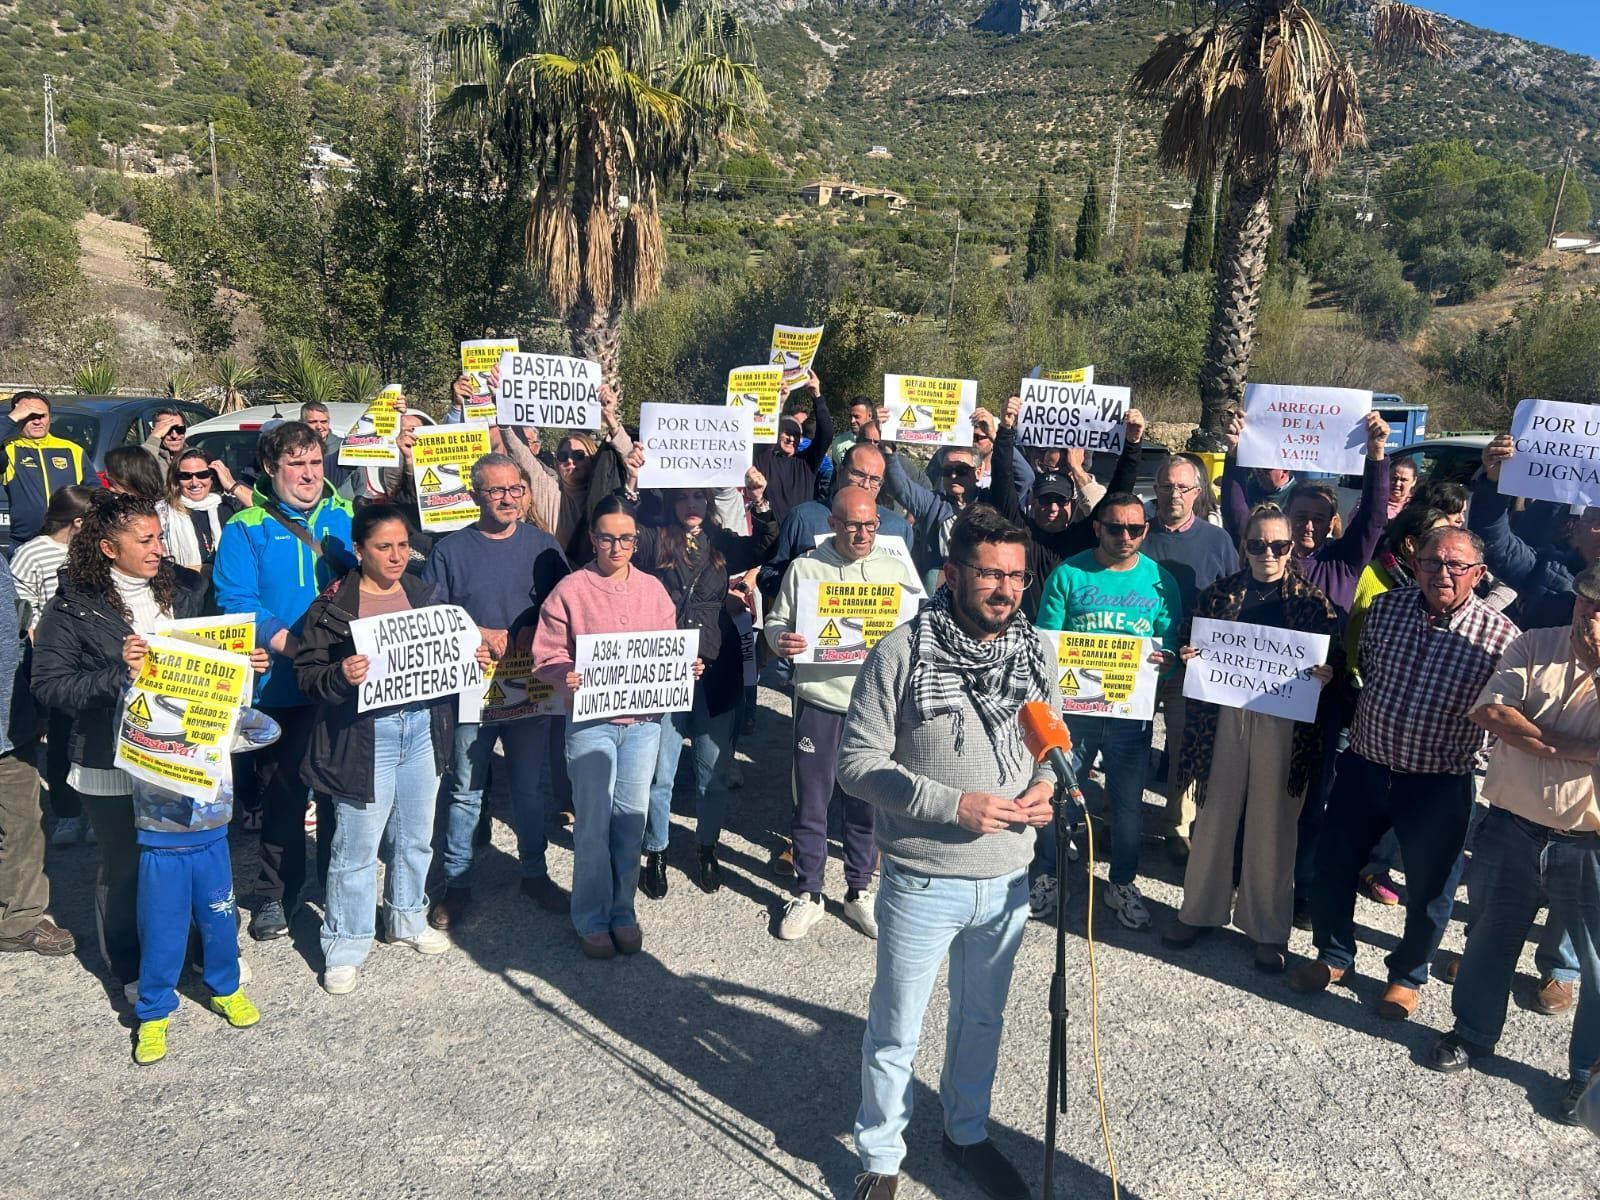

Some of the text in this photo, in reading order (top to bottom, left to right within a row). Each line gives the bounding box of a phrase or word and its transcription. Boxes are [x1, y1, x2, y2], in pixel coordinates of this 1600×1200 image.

[513, 356, 588, 378] BASTA YA
[503, 379, 523, 399] DE
[529, 376, 597, 401] PÉRDIDA
[905, 380, 957, 390] SIERRA DE CÁDIZ
[1024, 385, 1096, 406] AUTOVÍA
[515, 404, 535, 423] DE
[540, 405, 586, 425] VIDAS
[1022, 405, 1080, 426] ARCOS
[1267, 402, 1341, 416] ARREGLO
[657, 417, 689, 431] POR
[695, 418, 739, 432] UNAS
[1282, 418, 1325, 430] DE LA
[1532, 416, 1575, 434] POR
[418, 433, 482, 446] SIERRA DE CÁDIZ
[647, 438, 746, 451] CARRETERAS
[1021, 426, 1121, 451] ANTEQUERA
[1283, 434, 1320, 446] A-393
[436, 446, 468, 455] CARAVANA
[1281, 449, 1319, 462] YA!!!!
[1515, 439, 1600, 460] CARRET
[660, 456, 732, 469] DIGNAS!!
[1528, 462, 1600, 484] DIGNA
[826, 585, 895, 596] SIERRA DE CÁDIZ
[1071, 585, 1159, 613] Bowling
[219, 627, 246, 640] CÁDIZ
[373, 608, 466, 654] ¡ARREGLO DE
[592, 636, 686, 662] A384: PROMESAS
[1066, 637, 1136, 650] SIERRA DE CÁDIZ
[1212, 632, 1305, 660] POR UNAS
[388, 636, 460, 674] NUESTRAS
[1082, 650, 1117, 659] CARAVANA
[1199, 648, 1313, 682] CARRETERAS
[162, 670, 210, 688] CARAVANA
[186, 659, 200, 672] DE
[204, 663, 236, 680] CÁDIZ
[583, 661, 688, 688] INCUMPLIDAS DE LA
[145, 679, 162, 689] unas
[166, 685, 208, 697] carreteras
[211, 693, 238, 704] dignas
[363, 661, 481, 706] CARRETERAS YA!
[1209, 669, 1293, 699] DIGNAS!!
[578, 682, 690, 716] JUNTA DE ANDALUCÍA
[190, 705, 228, 719] SÁBADO 22
[186, 717, 226, 731] NOVIEMBRE
